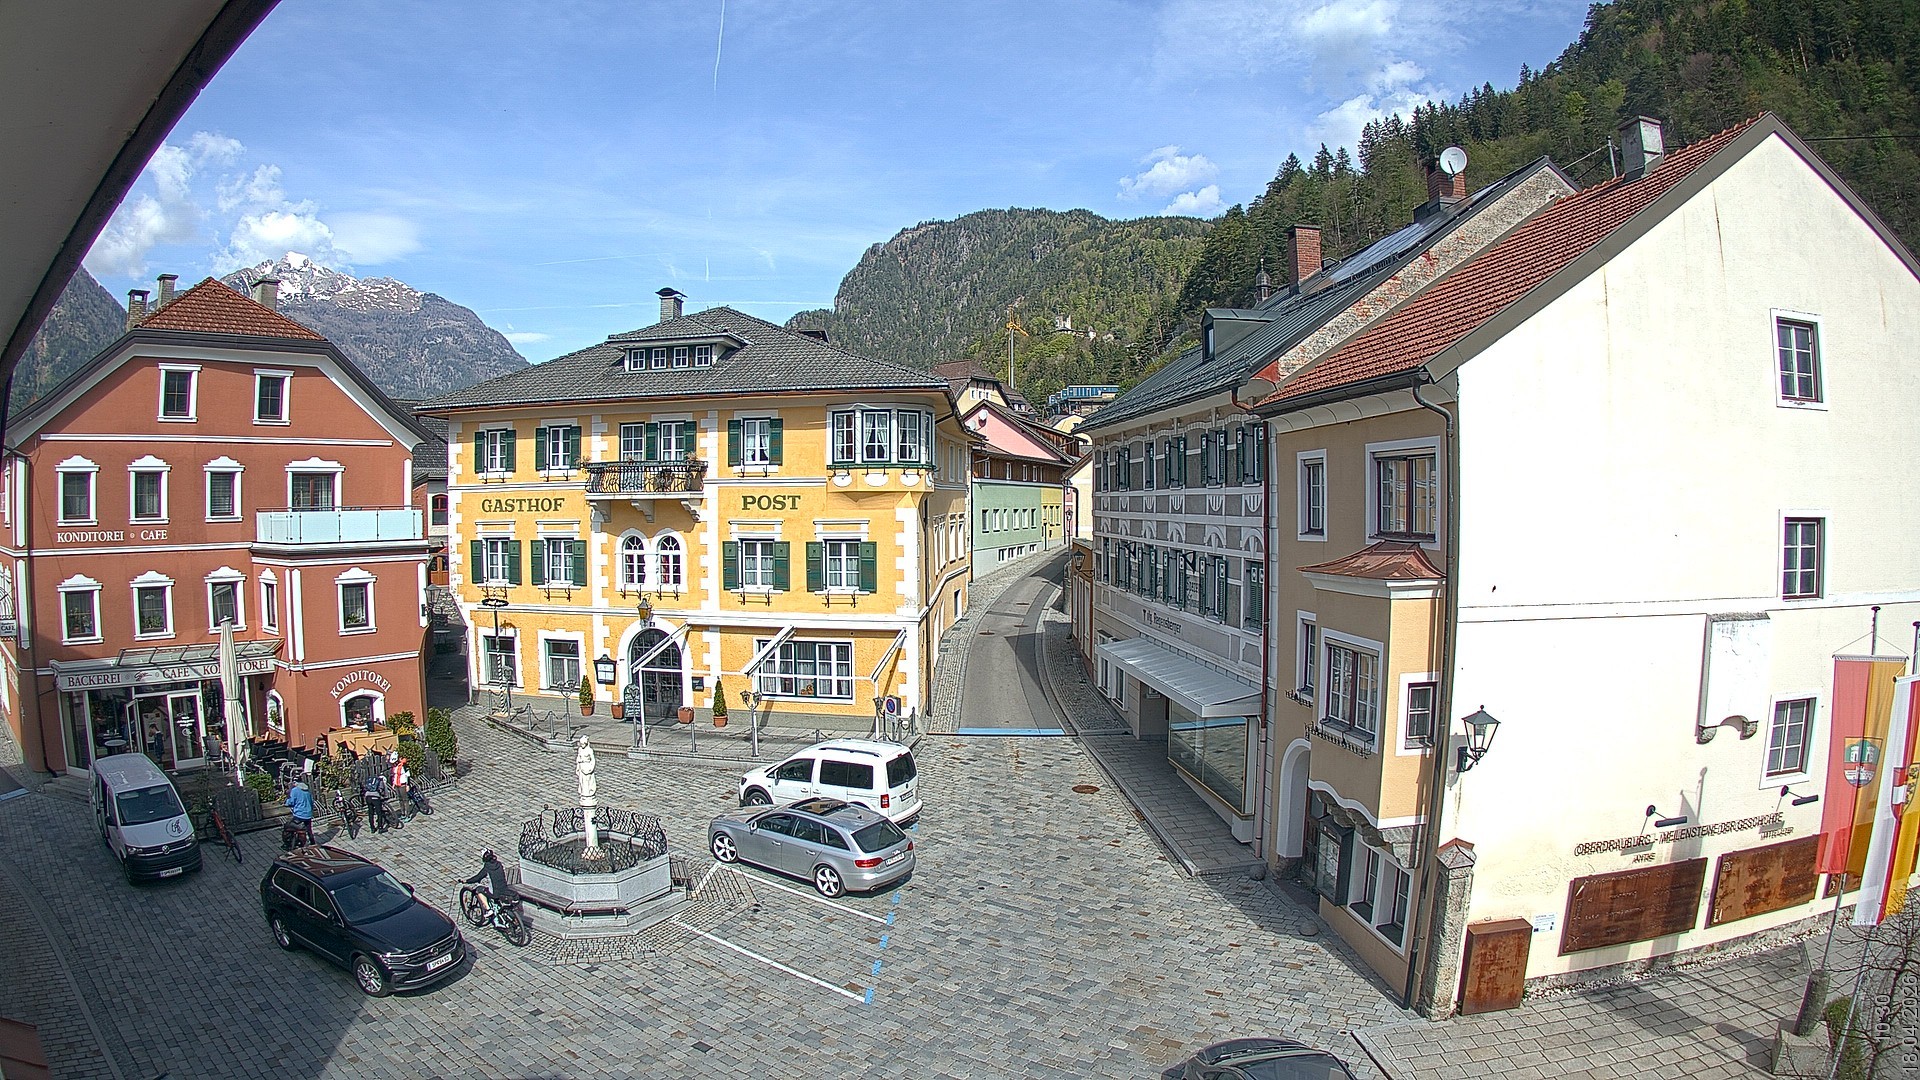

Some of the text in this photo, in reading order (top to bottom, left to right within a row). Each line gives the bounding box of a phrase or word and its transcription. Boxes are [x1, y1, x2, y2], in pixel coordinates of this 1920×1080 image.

[481, 495, 801, 513] GASTHOF POST
[57, 530, 168, 542] KONDITOREI CAFE
[68, 674, 121, 687] BÄCKEREI
[163, 668, 190, 679] CAFE
[203, 659, 269, 675] KOTOREI
[330, 670, 392, 699] KONDITOREI
